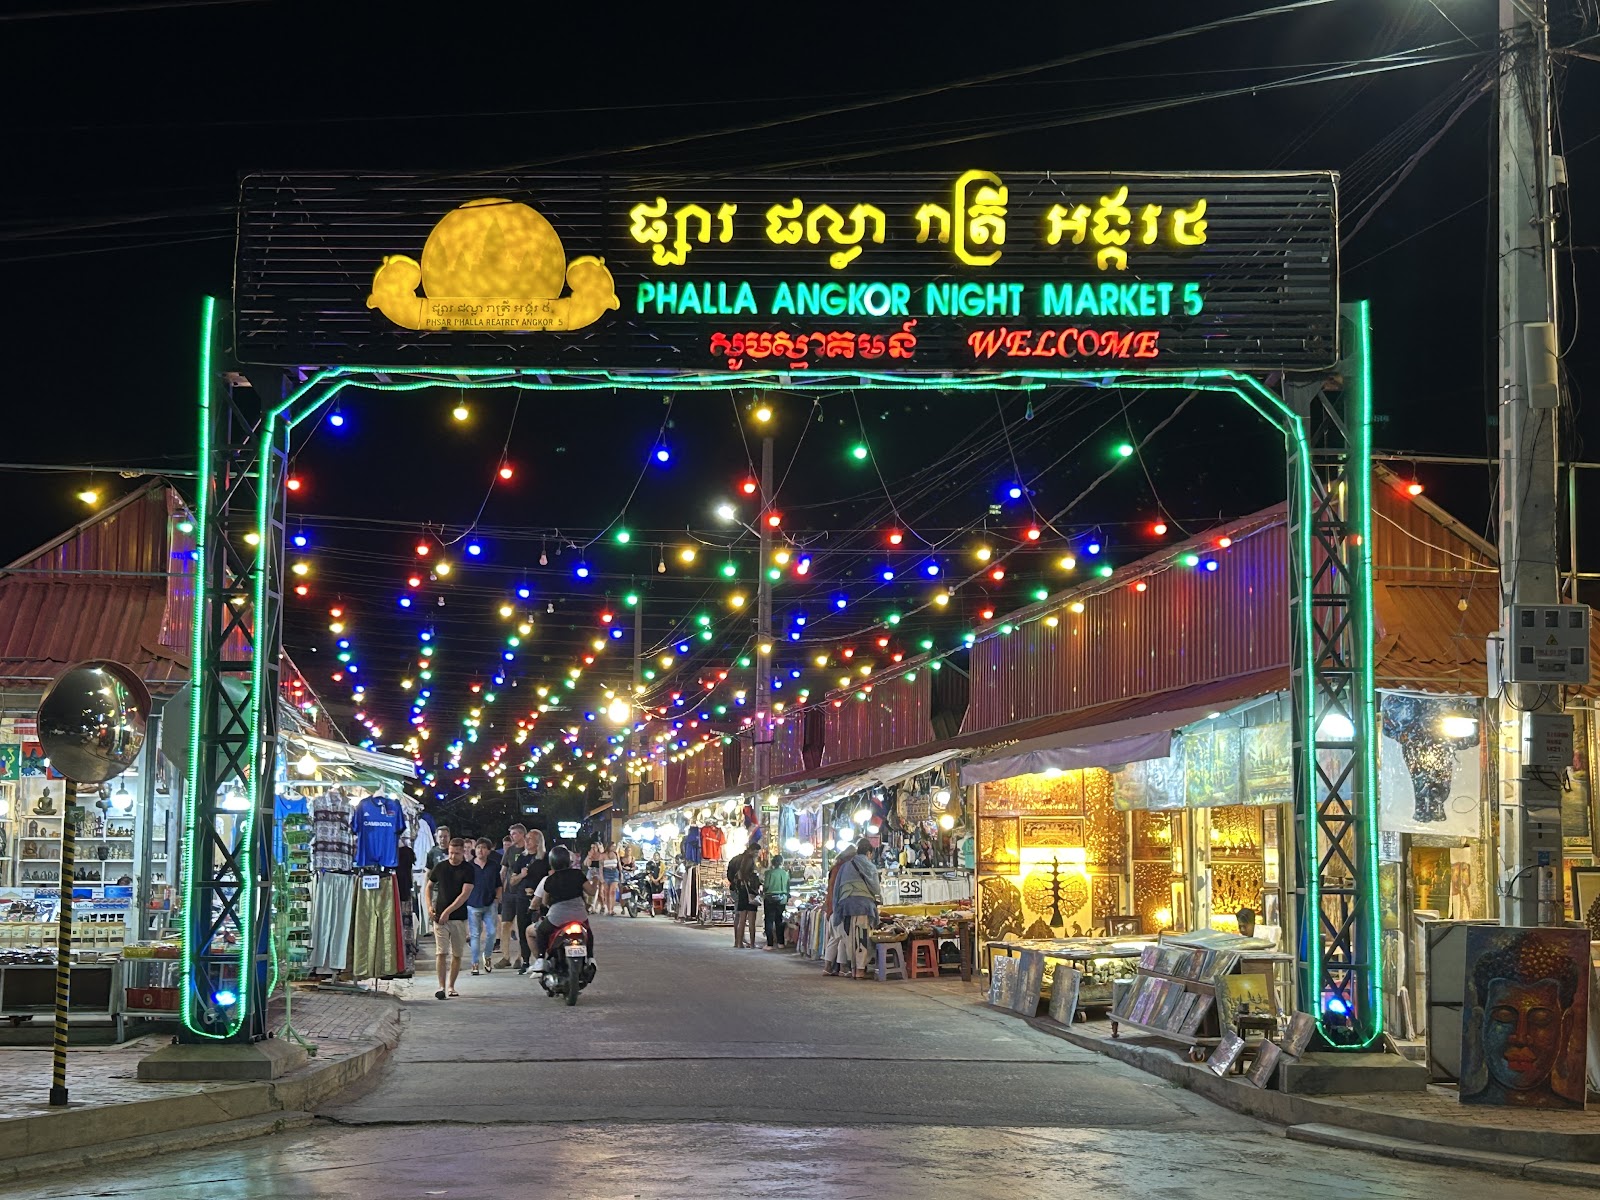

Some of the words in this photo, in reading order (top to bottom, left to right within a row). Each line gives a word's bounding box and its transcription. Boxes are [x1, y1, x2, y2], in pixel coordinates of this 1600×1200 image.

[636, 281, 758, 315] PHALLA
[770, 281, 911, 317] ANGKOR
[925, 281, 1025, 317] NIGHT
[1042, 281, 1174, 317] MARKET
[1182, 282, 1204, 316] 5
[426, 318, 452, 327] PHSAR
[454, 318, 484, 327] PHALLA
[486, 318, 520, 327] REATREY
[521, 318, 553, 327] ANGKOR
[558, 318, 563, 326] 5
[967, 326, 1160, 359] WELCOME
[900, 880, 921, 894] 3$
